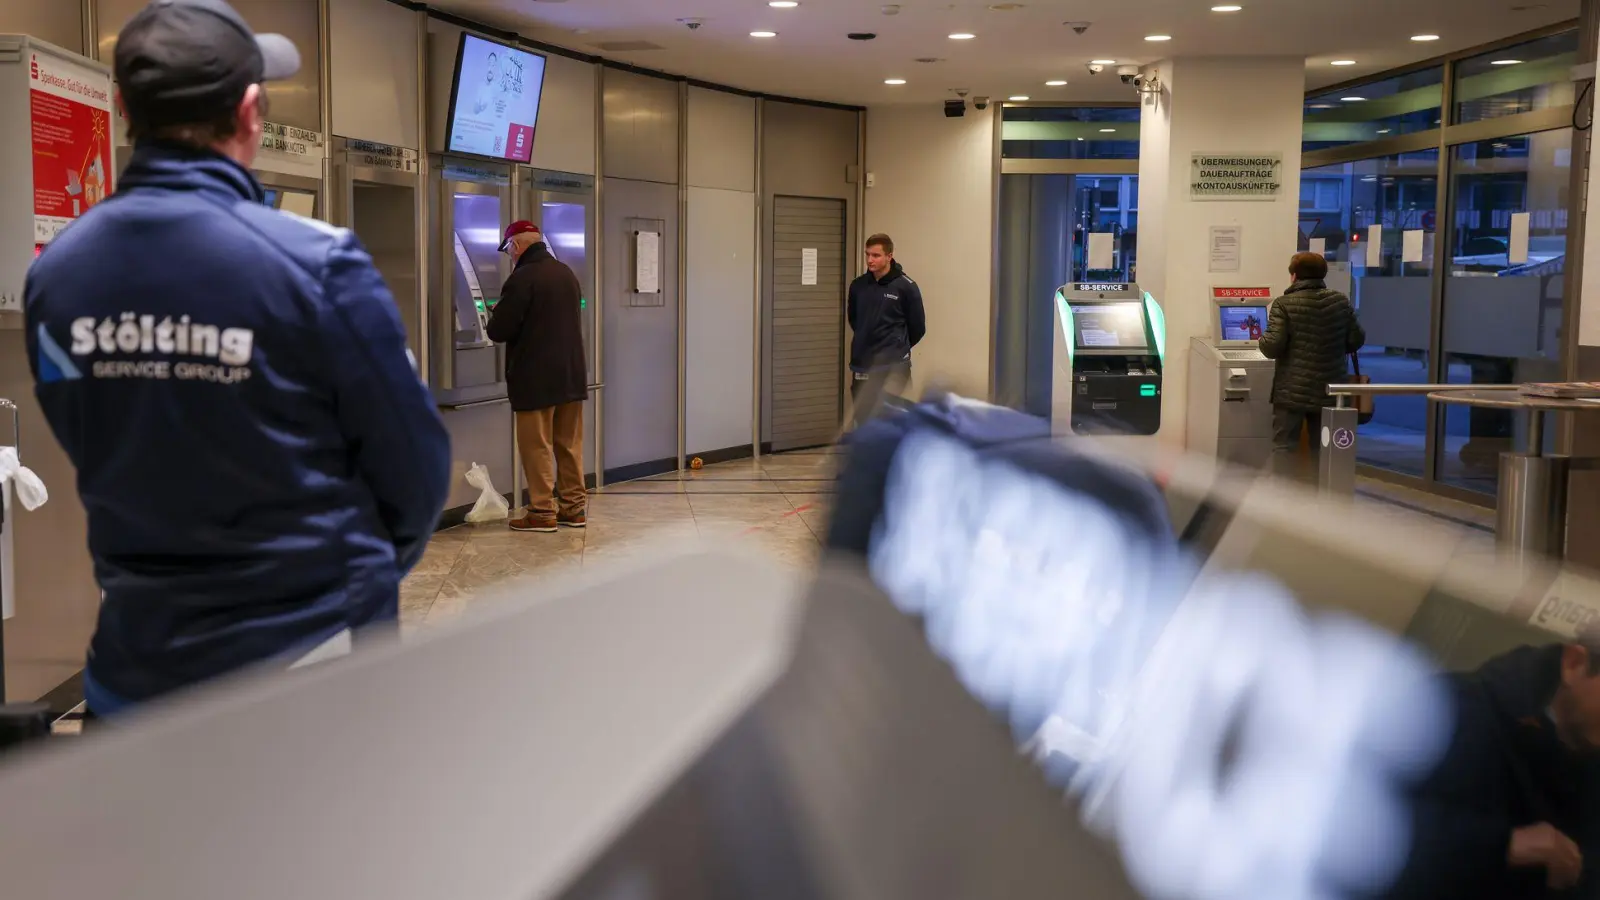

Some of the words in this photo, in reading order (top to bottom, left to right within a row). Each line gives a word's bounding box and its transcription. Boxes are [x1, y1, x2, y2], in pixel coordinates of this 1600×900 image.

[41, 70, 66, 88] Sparkasse.
[67, 79, 76, 92] Gut
[91, 88, 108, 103] Umwelt.
[277, 126, 288, 136] UND
[290, 128, 317, 142] EINZAHLEN
[262, 136, 274, 148] VON
[275, 139, 307, 154] BANKNOTEN
[1201, 157, 1272, 166] ÜBERWEISUNGEN
[1200, 170, 1272, 178] DAUERAUFTRÄGE
[1197, 182, 1275, 190] KONTOAUSKÜNFTE
[1221, 289, 1263, 297] SB-SERVICE
[70, 311, 253, 366] Stölting
[92, 360, 170, 379] SERVICE
[174, 362, 251, 384] GROUP
